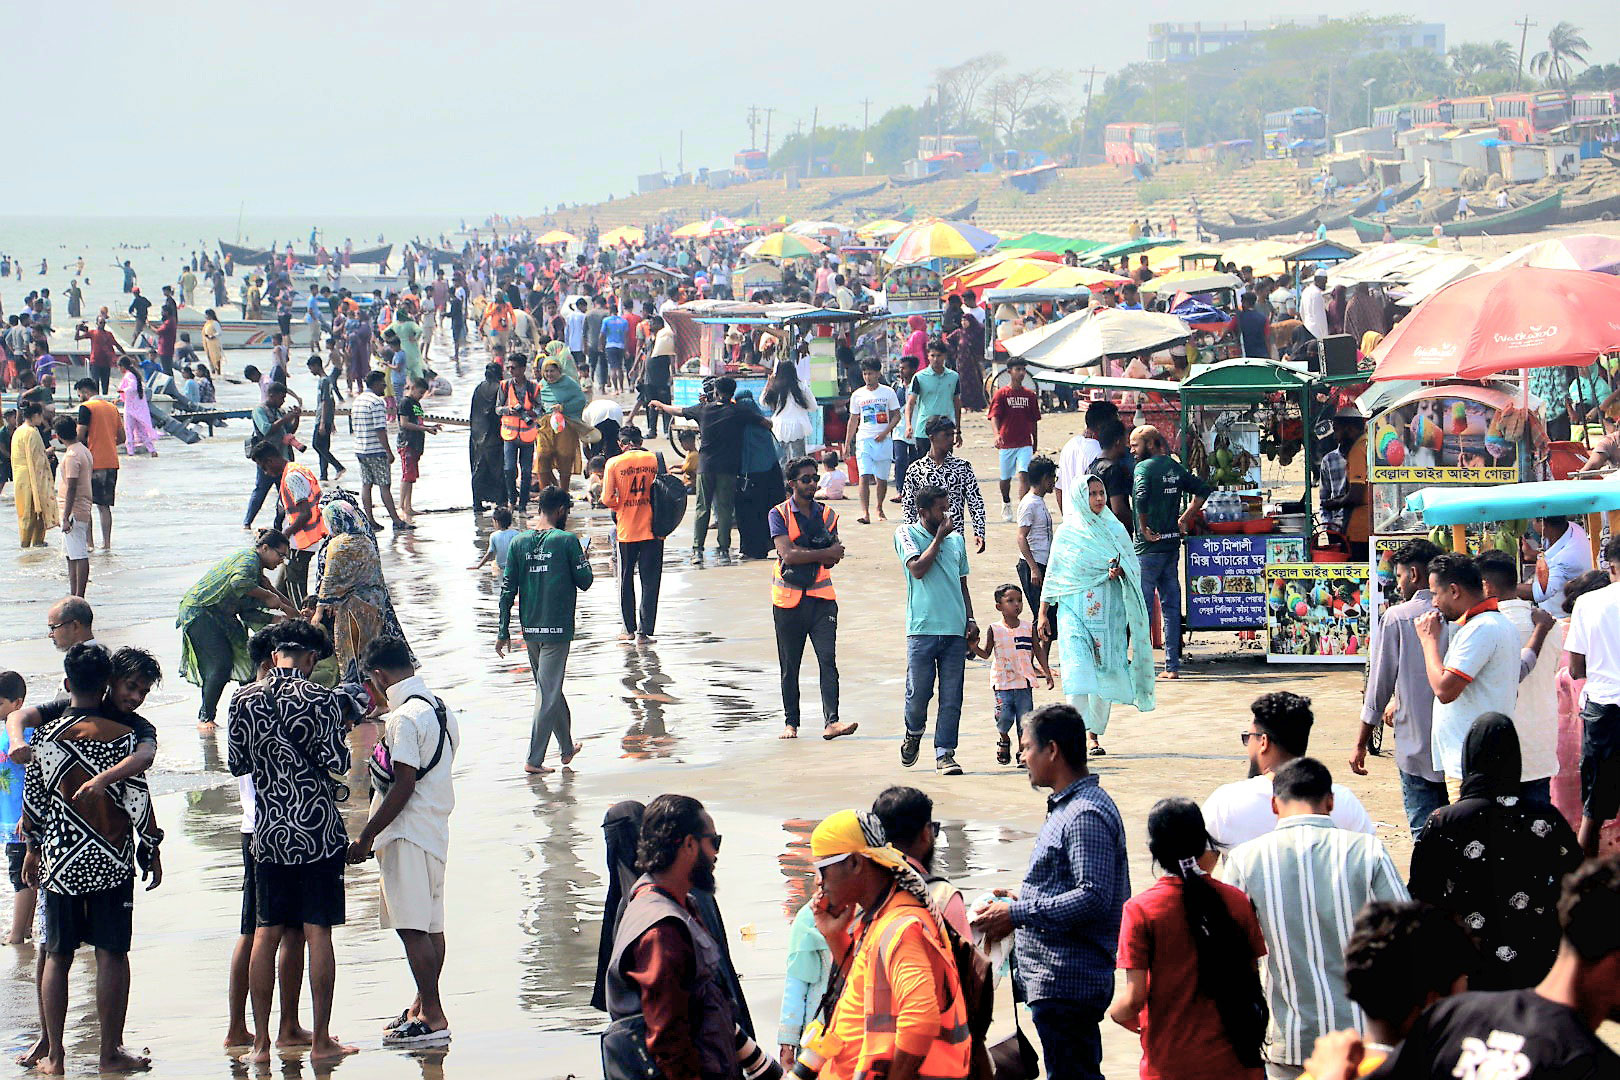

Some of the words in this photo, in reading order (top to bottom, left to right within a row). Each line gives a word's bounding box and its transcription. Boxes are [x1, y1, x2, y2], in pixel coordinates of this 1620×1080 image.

[1006, 396, 1029, 406] WEALTHY
[1413, 467, 1442, 480] ভাইর
[1447, 467, 1480, 480] আইস
[630, 475, 646, 496] 44
[1203, 538, 1220, 552] পাঁচ
[1222, 538, 1252, 552] মিশালী
[1190, 553, 1210, 567] মিক্স
[1251, 554, 1265, 566] ঘর
[1301, 566, 1329, 578] ভাইর
[1332, 566, 1362, 578] আইস
